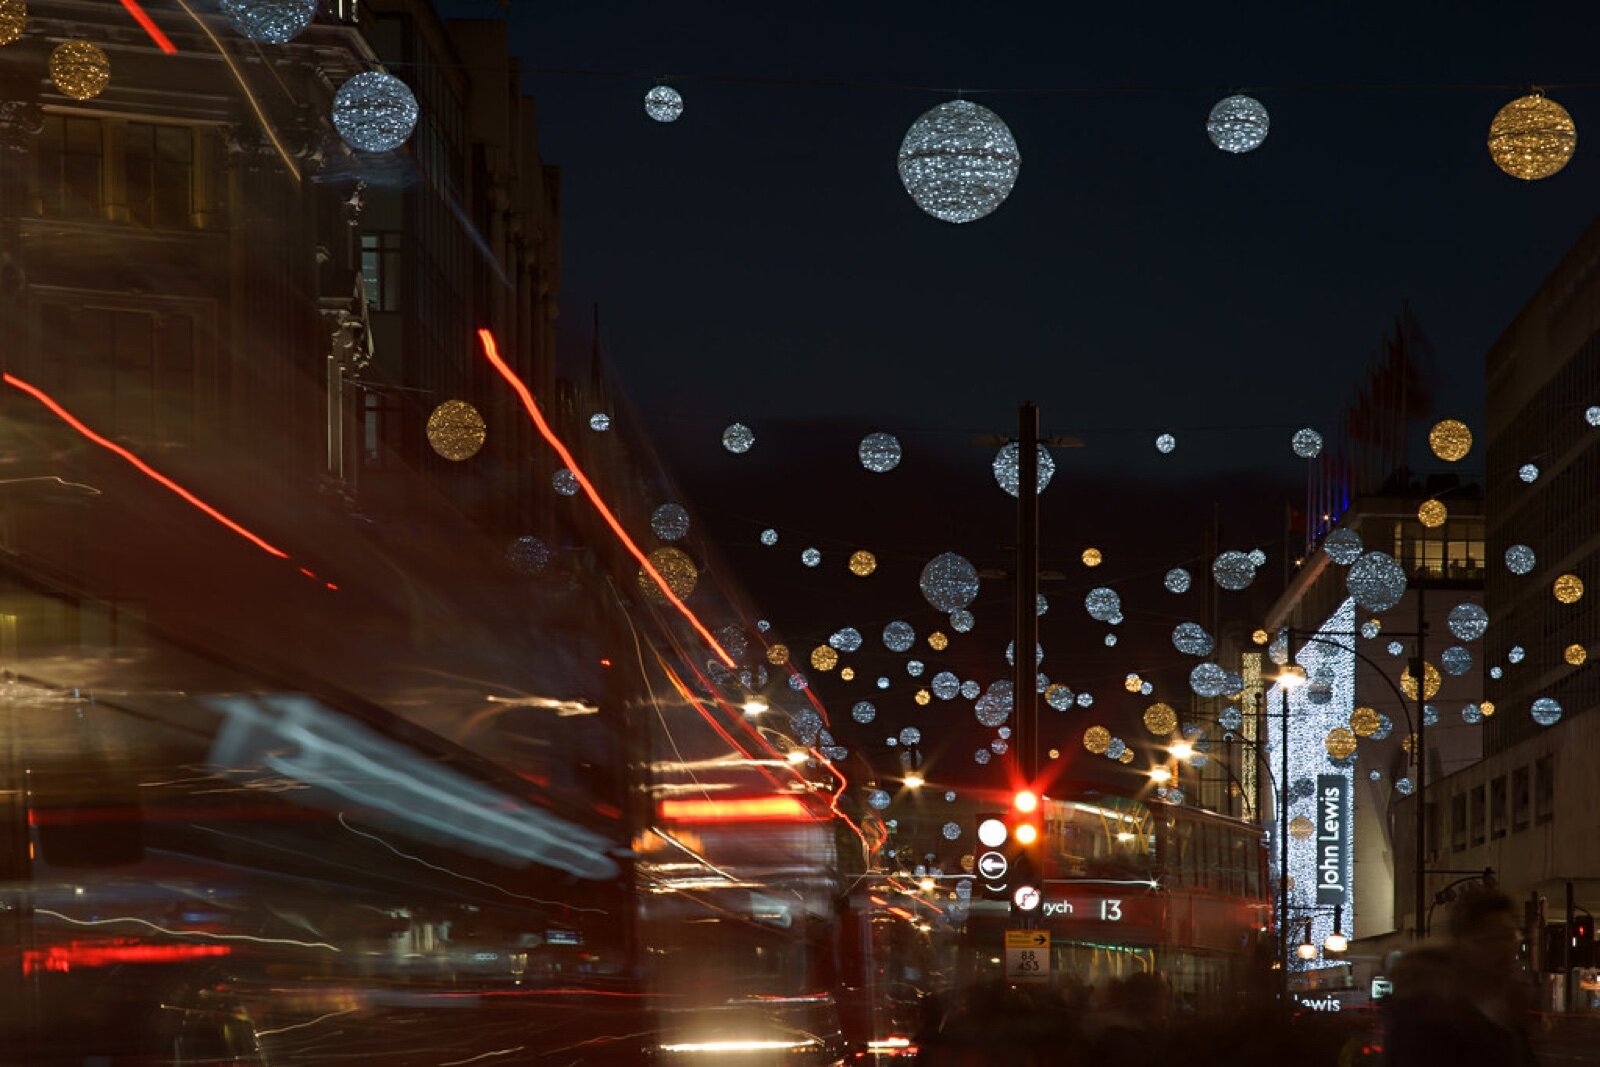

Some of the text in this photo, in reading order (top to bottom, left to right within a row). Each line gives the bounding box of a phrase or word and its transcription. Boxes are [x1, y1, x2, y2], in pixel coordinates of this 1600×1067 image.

[1319, 787, 1344, 892] John Lewis
[1100, 899, 1122, 921] 13
